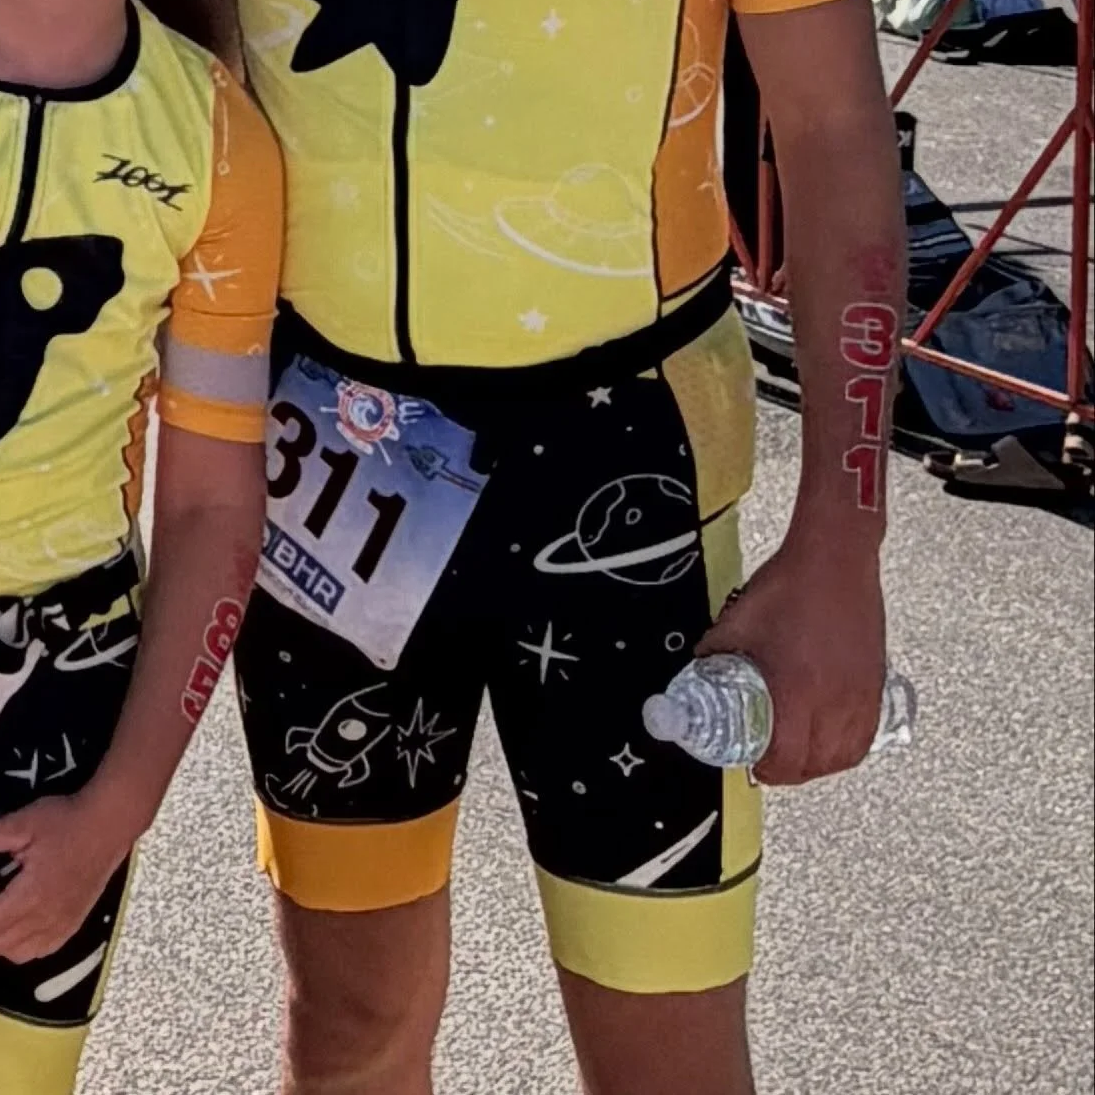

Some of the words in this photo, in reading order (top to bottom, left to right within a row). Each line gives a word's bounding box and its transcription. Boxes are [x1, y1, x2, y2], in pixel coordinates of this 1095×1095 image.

[266, 401, 408, 585] 311
[840, 301, 898, 512] 311
[272, 538, 338, 608] BHR
